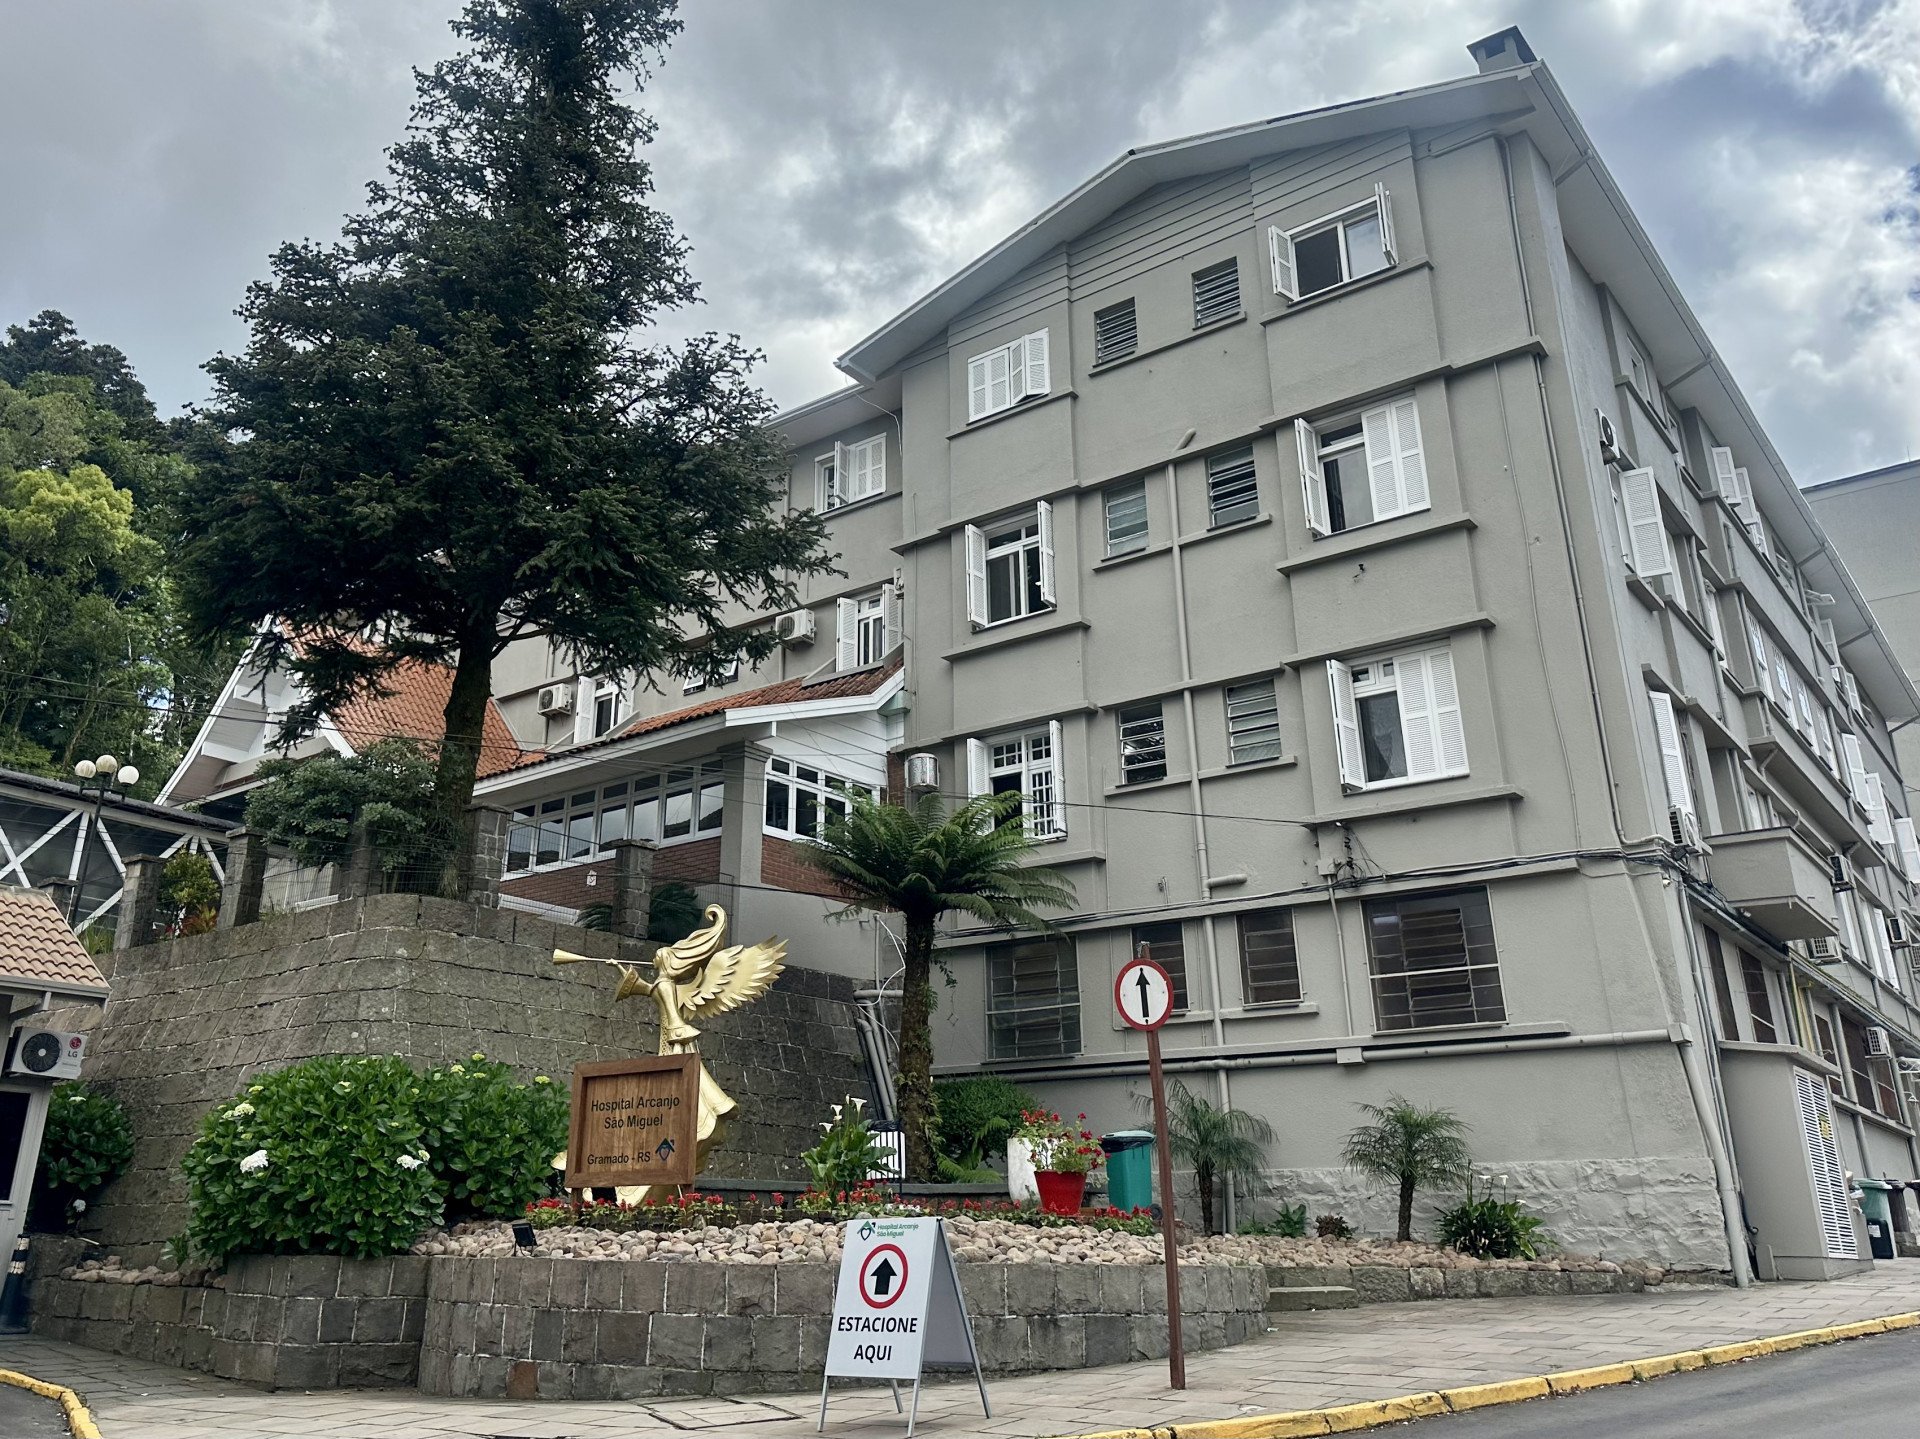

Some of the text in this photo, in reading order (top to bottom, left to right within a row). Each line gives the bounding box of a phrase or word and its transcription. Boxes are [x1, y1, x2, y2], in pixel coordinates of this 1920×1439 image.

[591, 1095, 680, 1113] Hospital Arcanjo
[604, 1114, 663, 1130] São Miguel
[587, 1153, 629, 1165] Gramado
[637, 1151, 651, 1163] RS
[837, 1317, 918, 1333] ESTACIONE
[853, 1344, 892, 1363] AQUI
